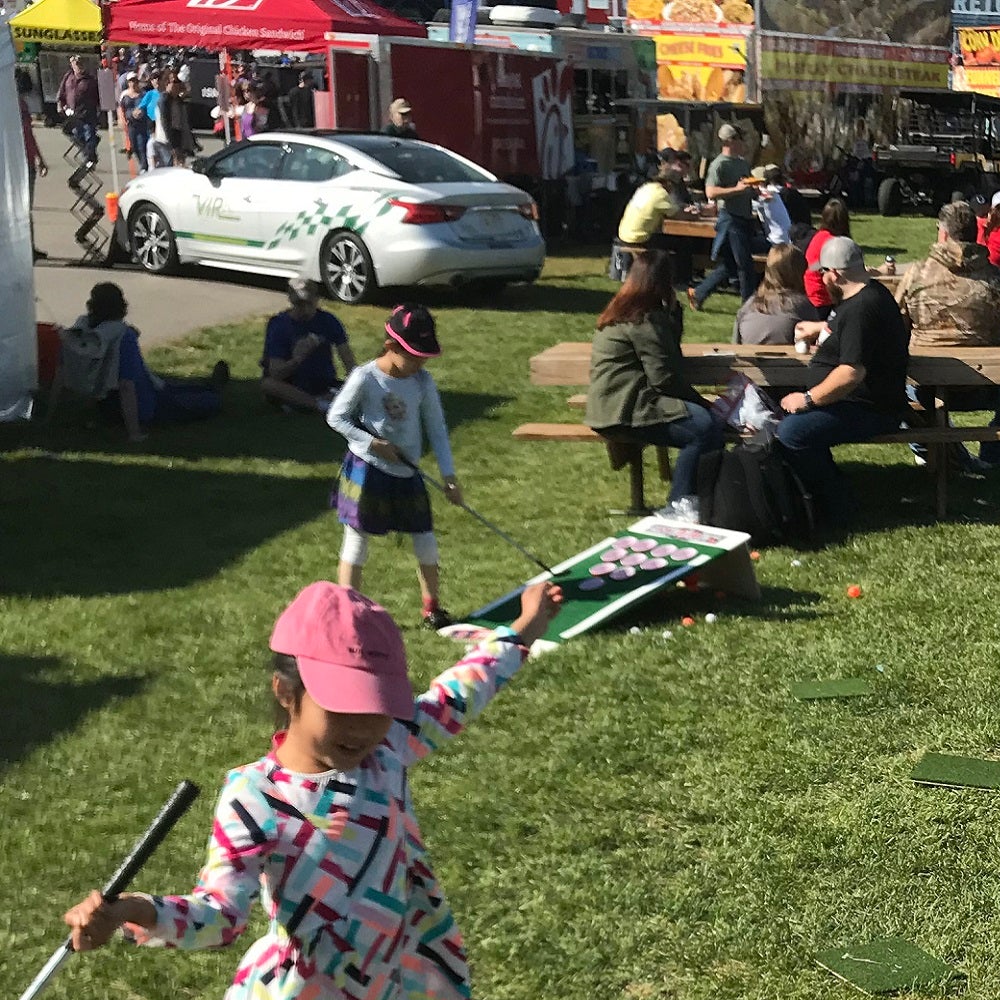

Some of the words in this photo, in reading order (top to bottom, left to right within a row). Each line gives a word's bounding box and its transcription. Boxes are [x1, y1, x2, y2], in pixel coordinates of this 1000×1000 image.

[169, 22, 185, 33] The
[186, 23, 222, 36] Original
[223, 24, 259, 37] Chicken
